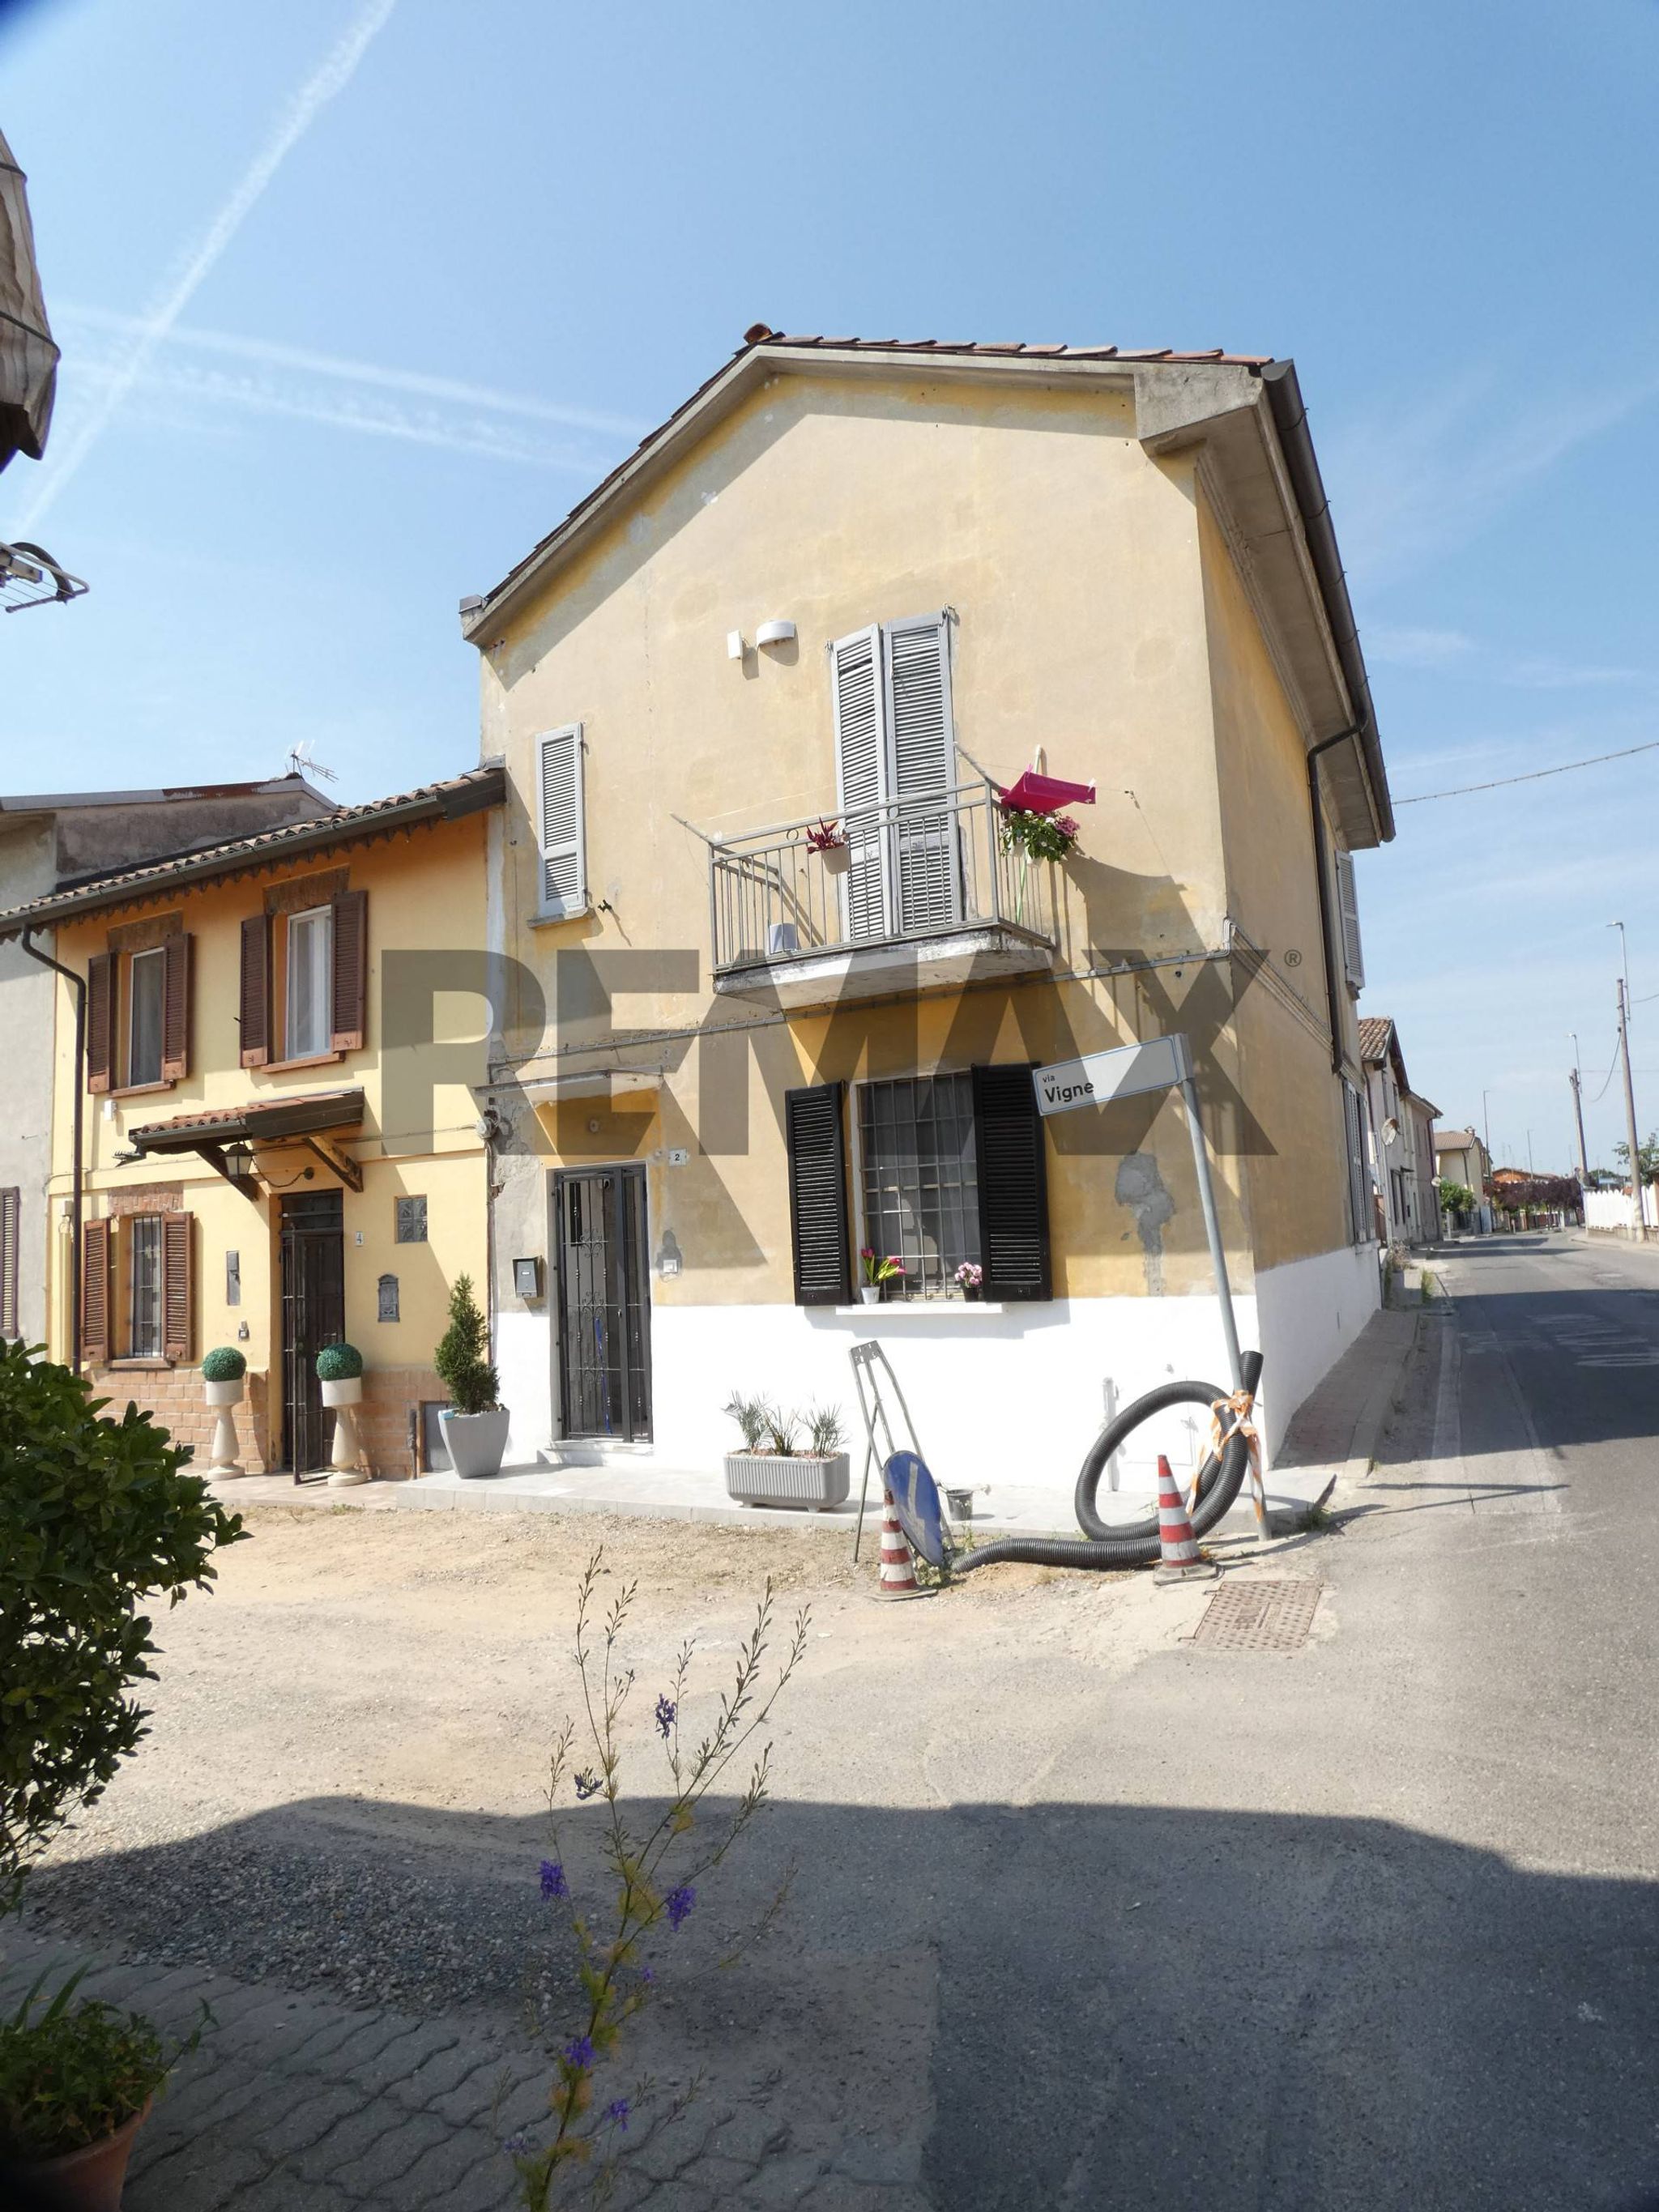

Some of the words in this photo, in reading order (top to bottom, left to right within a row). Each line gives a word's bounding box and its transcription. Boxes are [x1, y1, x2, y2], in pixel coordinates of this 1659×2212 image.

[1043, 1074, 1056, 1083] via
[1045, 1081, 1094, 1103] Vigne
[675, 1153, 680, 1161] 2
